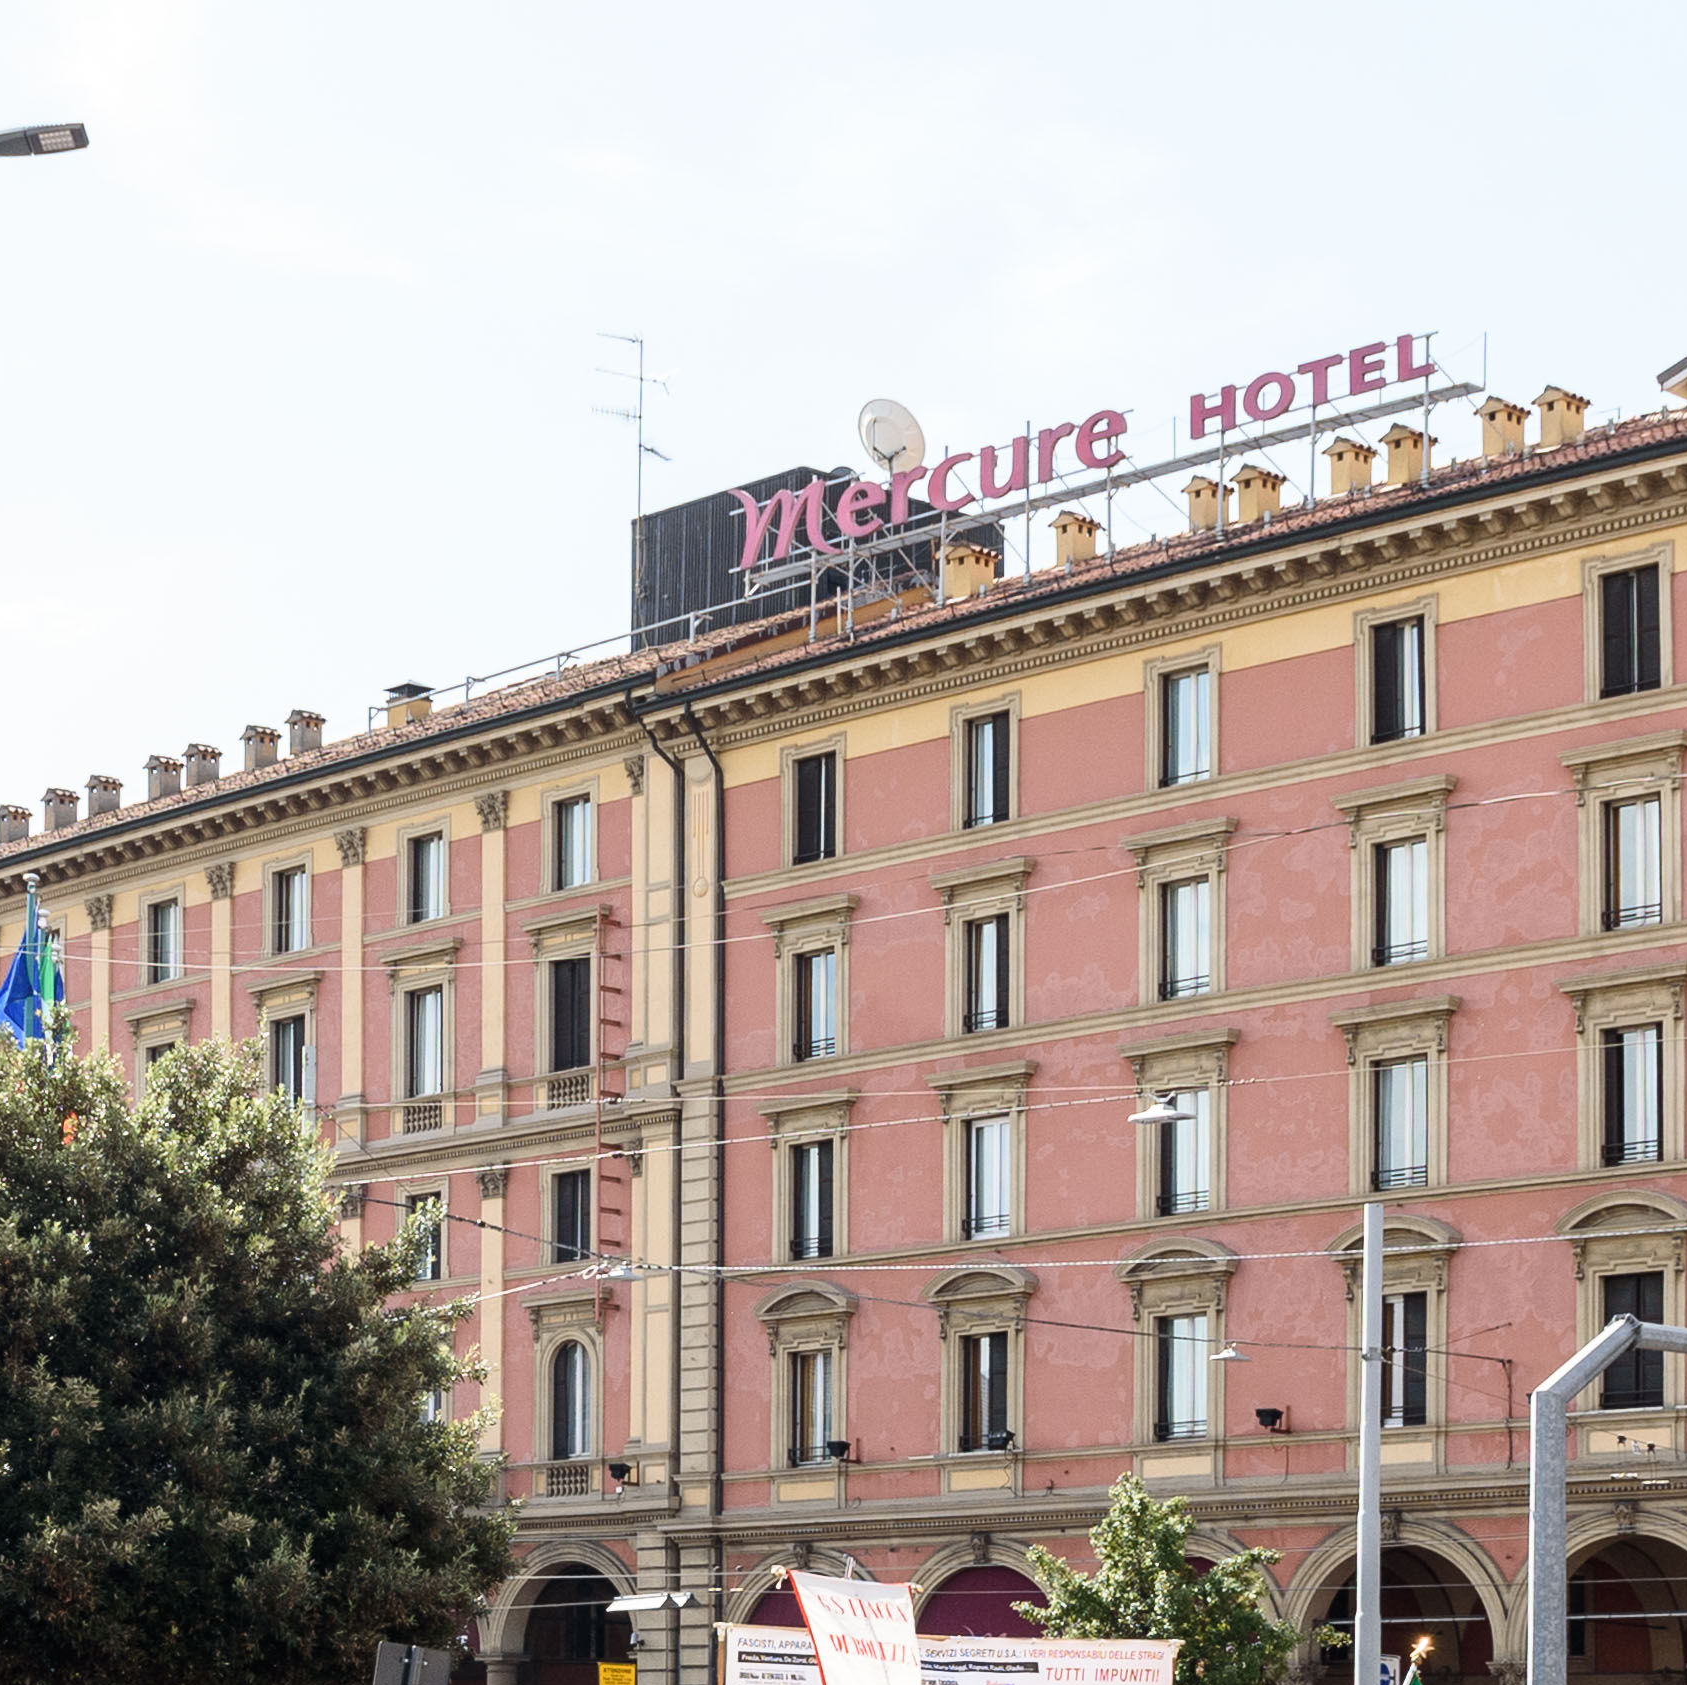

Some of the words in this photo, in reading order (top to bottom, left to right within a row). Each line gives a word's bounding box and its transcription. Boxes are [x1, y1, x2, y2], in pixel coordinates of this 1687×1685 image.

[730, 409, 1127, 570] Mercure
[1190, 333, 1436, 440] HOTEL
[779, 1640, 813, 1651] APPARA
[959, 1648, 995, 1658] SEGRETI
[1028, 1650, 1047, 1659] VERI
[1049, 1650, 1107, 1660] RESPONSABILI
[1109, 1651, 1136, 1660] DELLE
[1138, 1651, 1165, 1661] STRAGI
[1046, 1667, 1086, 1682] TUTTI
[1094, 1668, 1161, 1683] IMPUNITI!
